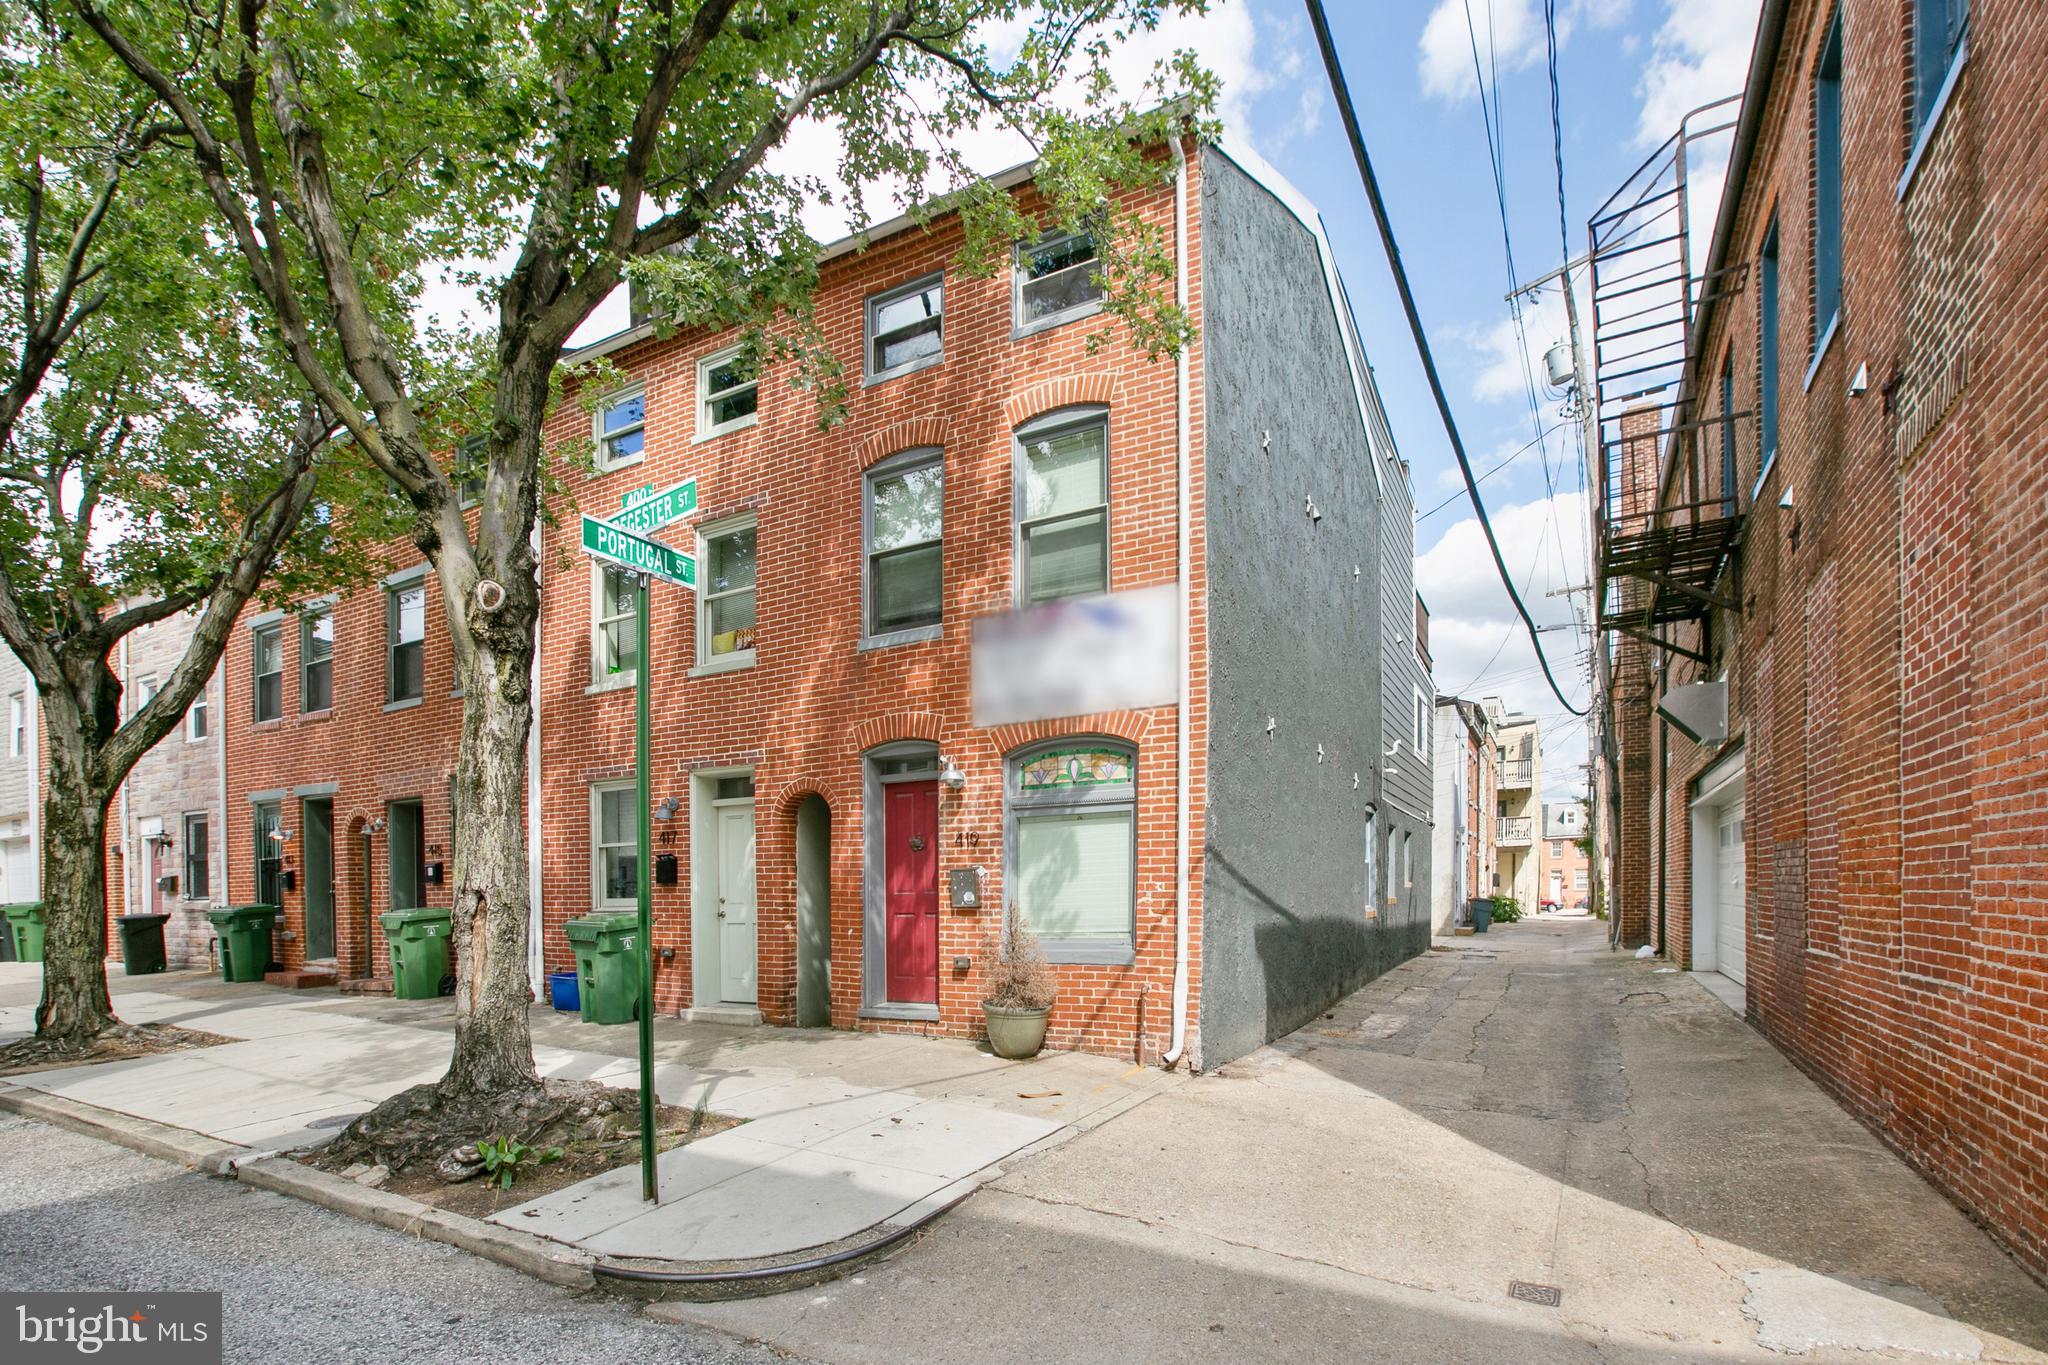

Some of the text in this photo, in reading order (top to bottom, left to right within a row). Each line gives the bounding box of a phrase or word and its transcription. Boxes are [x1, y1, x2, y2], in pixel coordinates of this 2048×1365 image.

[626, 488, 647, 506] 400
[612, 491, 691, 532] EGESTER ST.
[597, 526, 689, 577] PORTUGAL ST.
[659, 831, 677, 845] 417
[955, 832, 979, 849] 419
